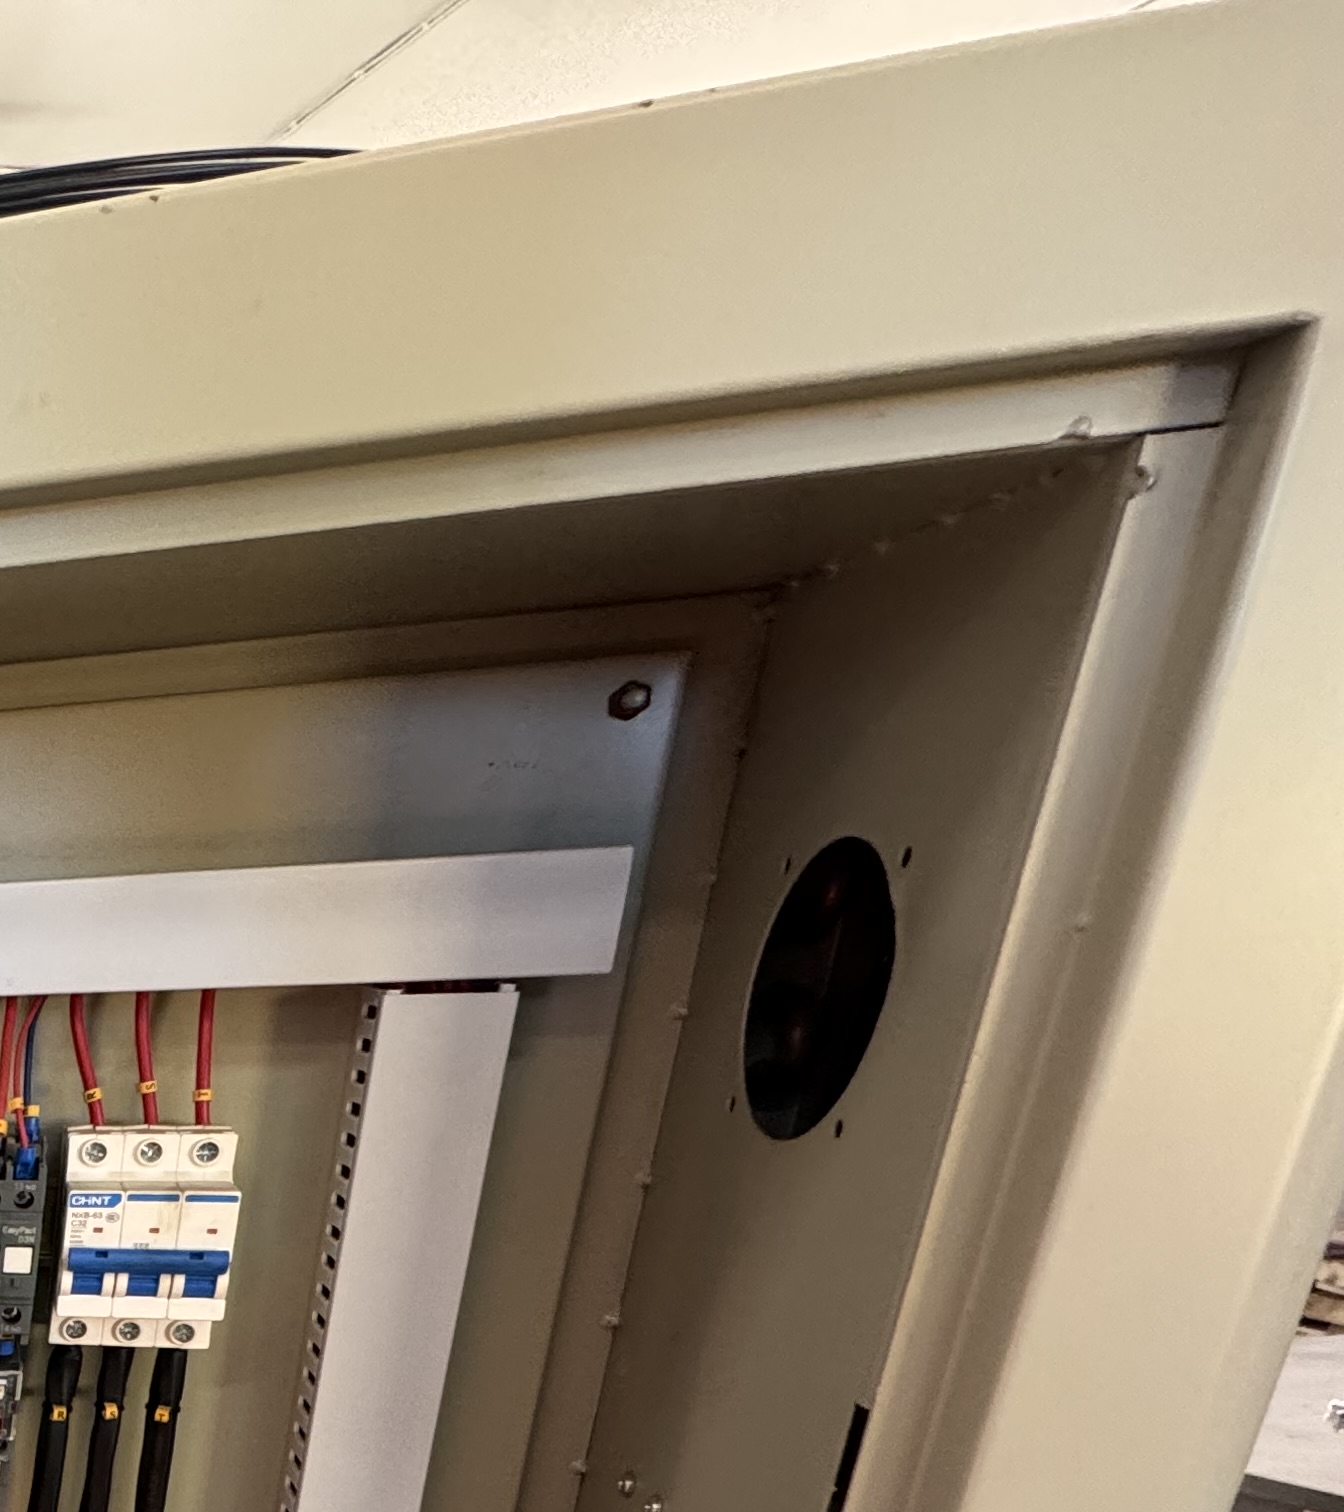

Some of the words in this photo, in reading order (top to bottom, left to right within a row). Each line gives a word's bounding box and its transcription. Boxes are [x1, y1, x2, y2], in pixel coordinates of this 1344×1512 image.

[86, 1091, 97, 1100] R
[57, 1411, 65, 1419] R
[110, 1410, 116, 1418] S
[158, 1413, 166, 1421] T
